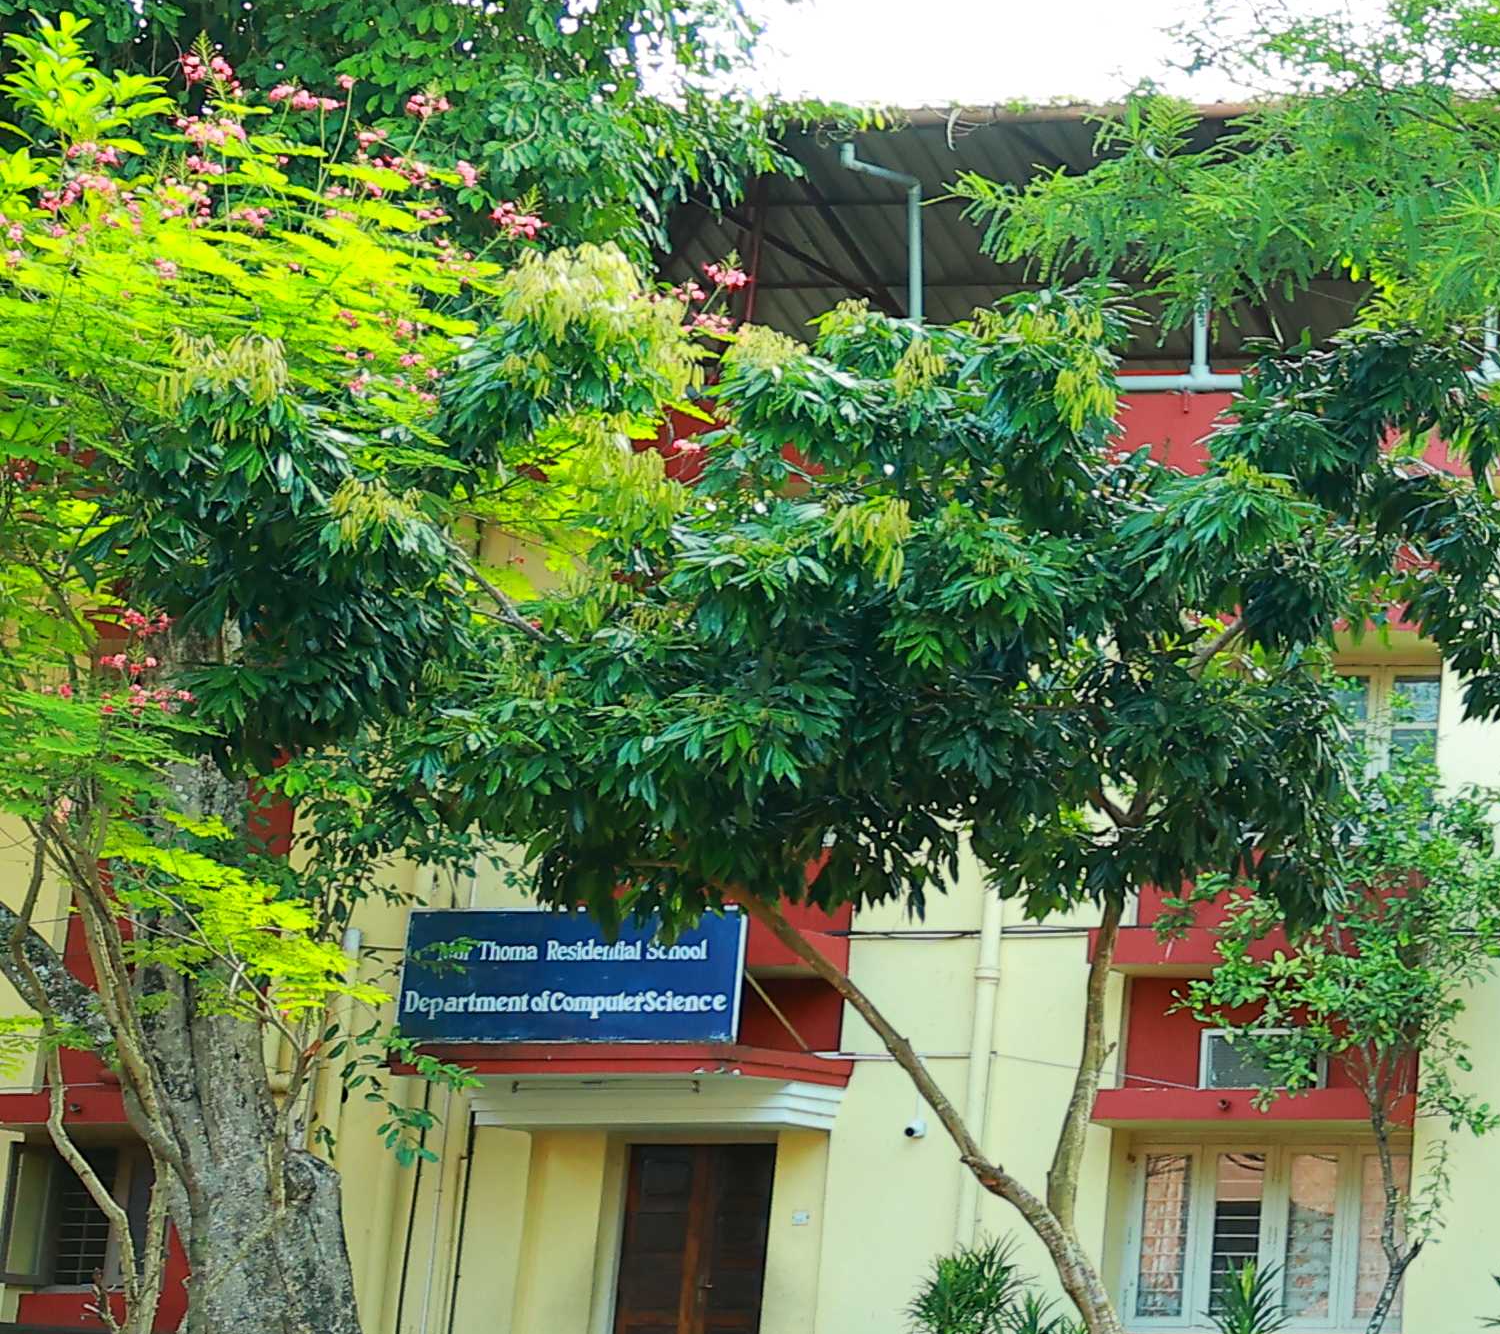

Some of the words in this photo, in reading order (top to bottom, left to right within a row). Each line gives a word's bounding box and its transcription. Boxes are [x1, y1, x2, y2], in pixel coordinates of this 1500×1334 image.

[479, 940, 538, 961] Thoma
[546, 938, 641, 961] Residential
[646, 939, 708, 961] School
[404, 990, 530, 1020] Department
[531, 990, 551, 1012] of
[550, 991, 645, 1020] Computer
[643, 990, 728, 1012] Science
